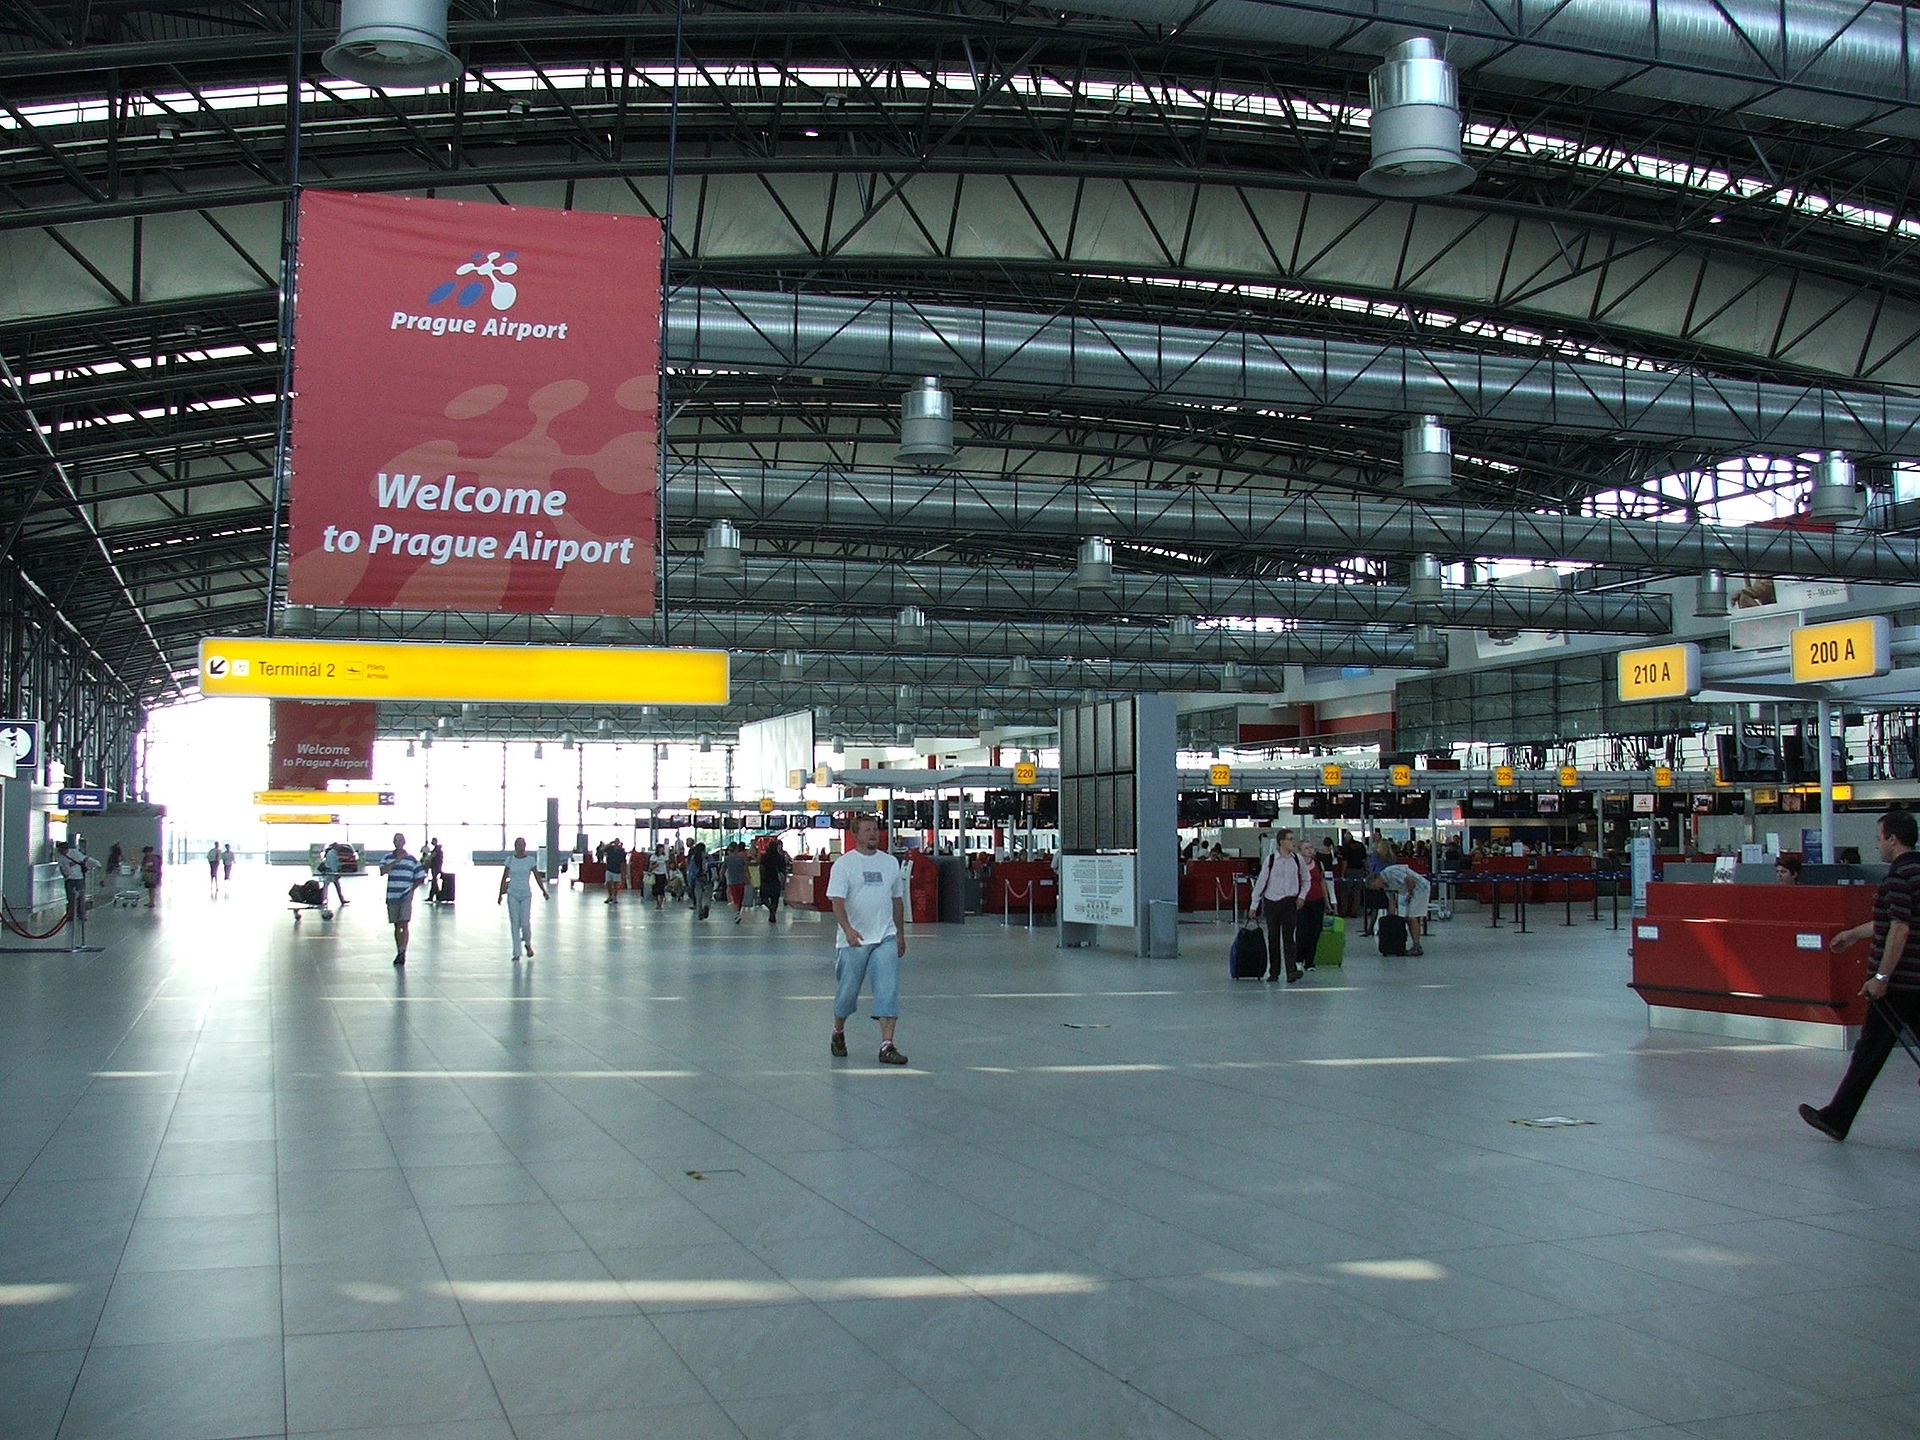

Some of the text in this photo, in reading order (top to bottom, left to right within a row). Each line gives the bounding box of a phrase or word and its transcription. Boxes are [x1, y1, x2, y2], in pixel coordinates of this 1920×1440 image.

[391, 311, 568, 341] Prague Airport
[376, 473, 567, 516] Welcome
[323, 524, 634, 570] to Prague Airport
[1810, 638, 1855, 665] 200 A
[258, 661, 335, 677] Terminál 2
[1634, 662, 1671, 685] 210 A
[297, 744, 350, 755] Welcome
[283, 758, 368, 769] to Prague Airport
[1017, 768, 1033, 778] 220
[1213, 771, 1228, 780] 222
[1325, 771, 1340, 780] 223
[1394, 771, 1409, 780] 224
[1656, 772, 1669, 781] 227
